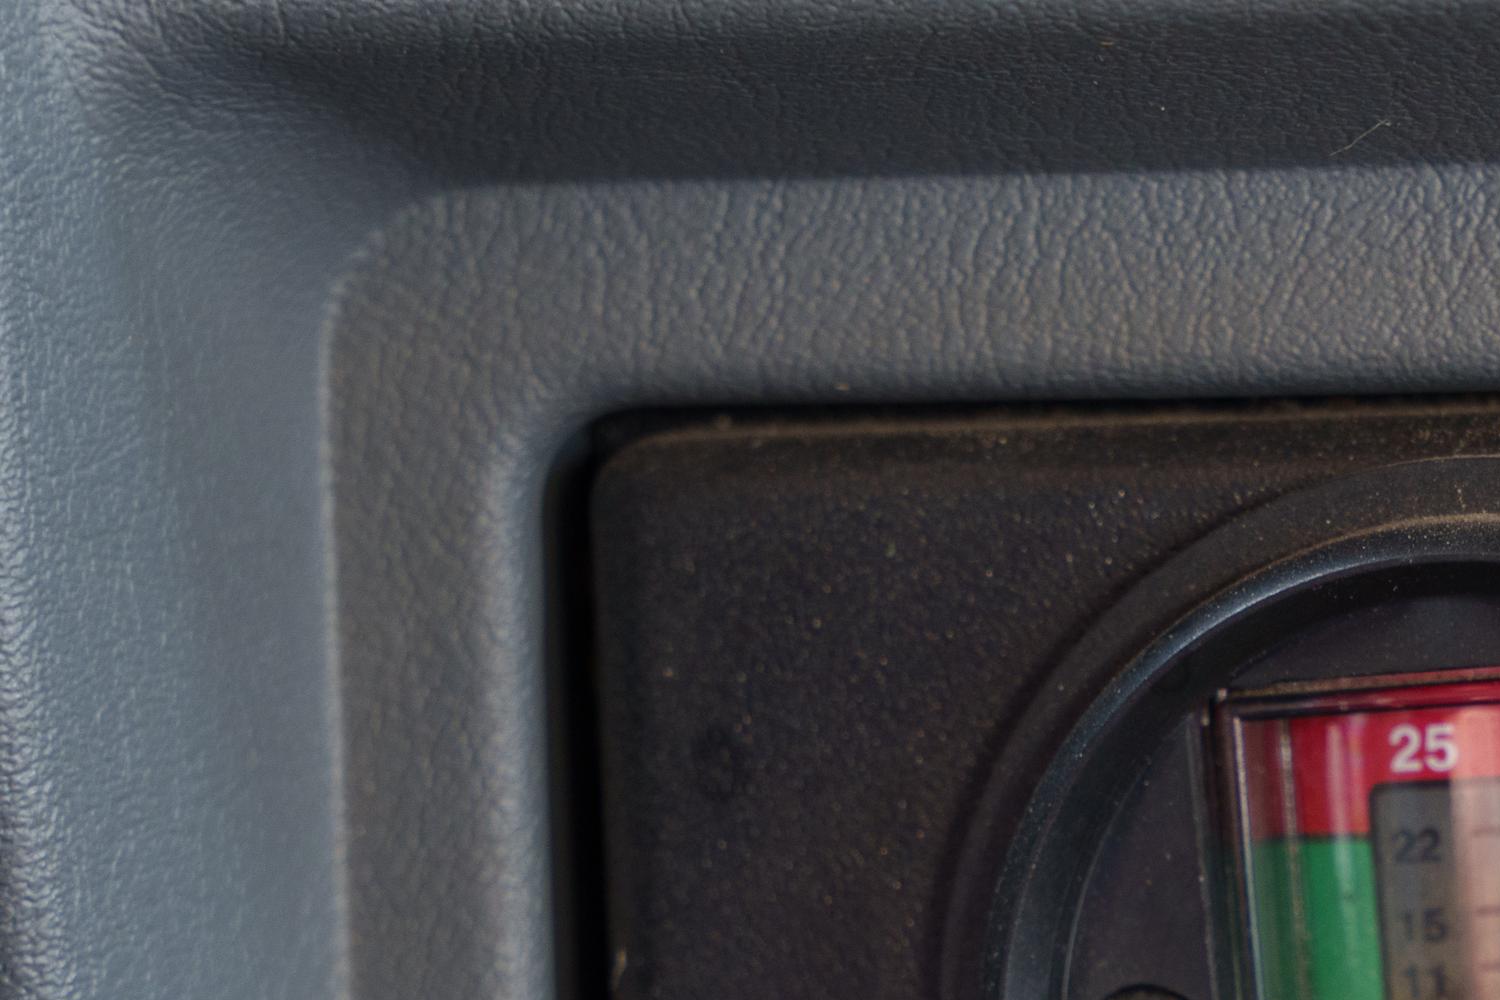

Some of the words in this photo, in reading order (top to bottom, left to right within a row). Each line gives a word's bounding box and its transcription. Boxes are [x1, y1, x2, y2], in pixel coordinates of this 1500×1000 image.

[1388, 722, 1460, 774] 25
[1394, 828, 1442, 864] 22
[1399, 908, 1447, 943] 15
[1403, 964, 1447, 1000] 11
